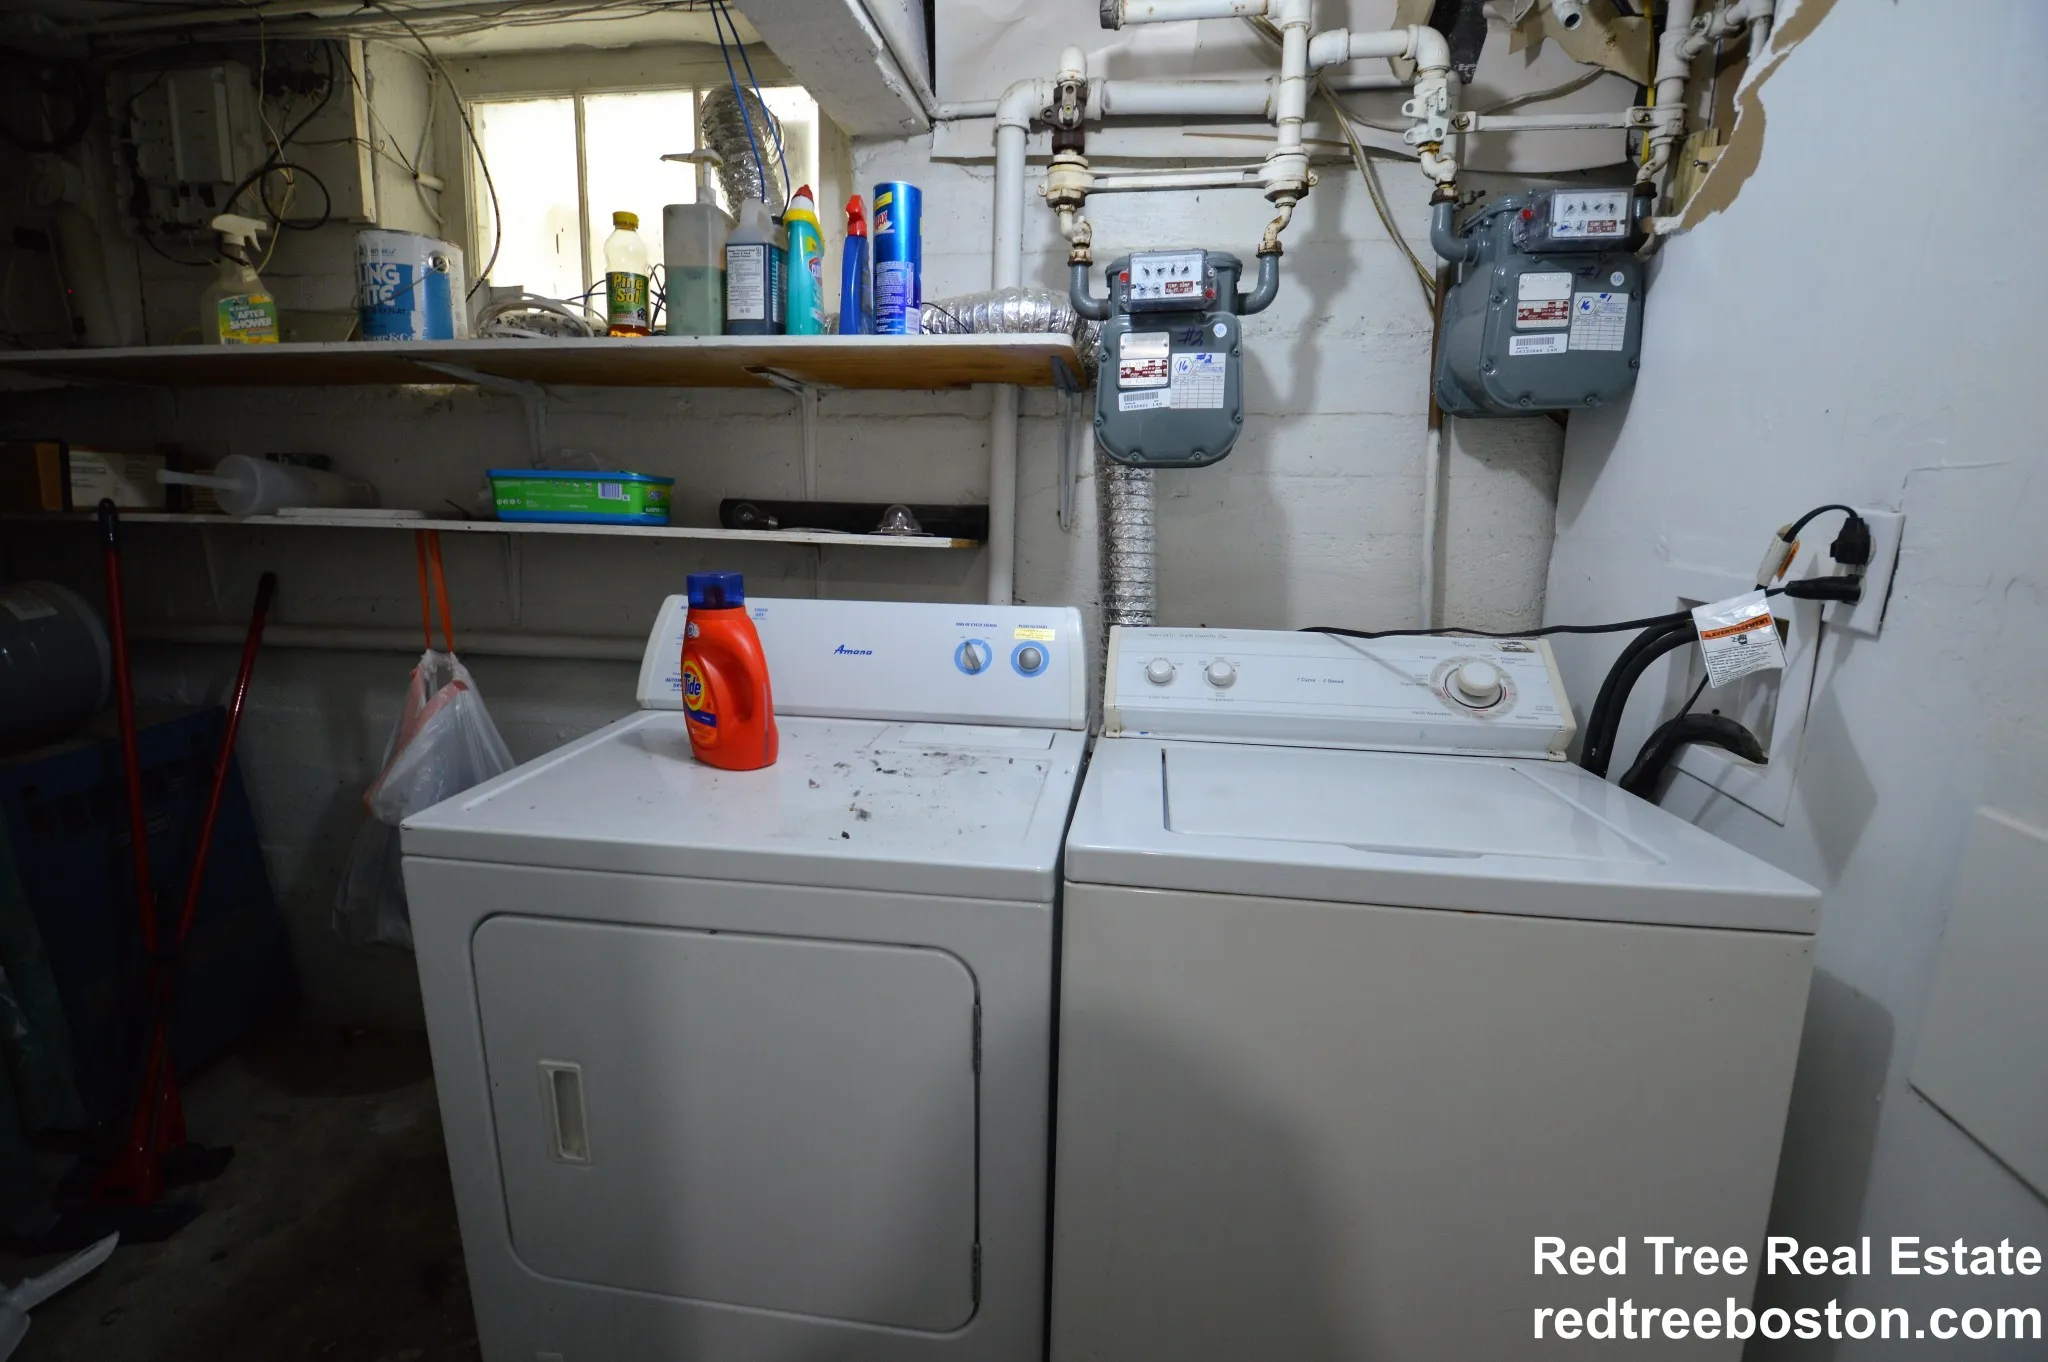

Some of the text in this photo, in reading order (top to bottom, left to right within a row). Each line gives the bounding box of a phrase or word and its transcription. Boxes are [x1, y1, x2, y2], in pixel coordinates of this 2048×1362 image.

[613, 273, 644, 291] Pine
[615, 288, 641, 304] Sol
[238, 309, 265, 320] AFTER
[229, 317, 272, 331] SHOWER
[1178, 360, 1189, 372] 16
[1711, 617, 1769, 637] AVERTISSEMENT
[833, 644, 873, 656] Amana
[684, 673, 702, 696] Tide
